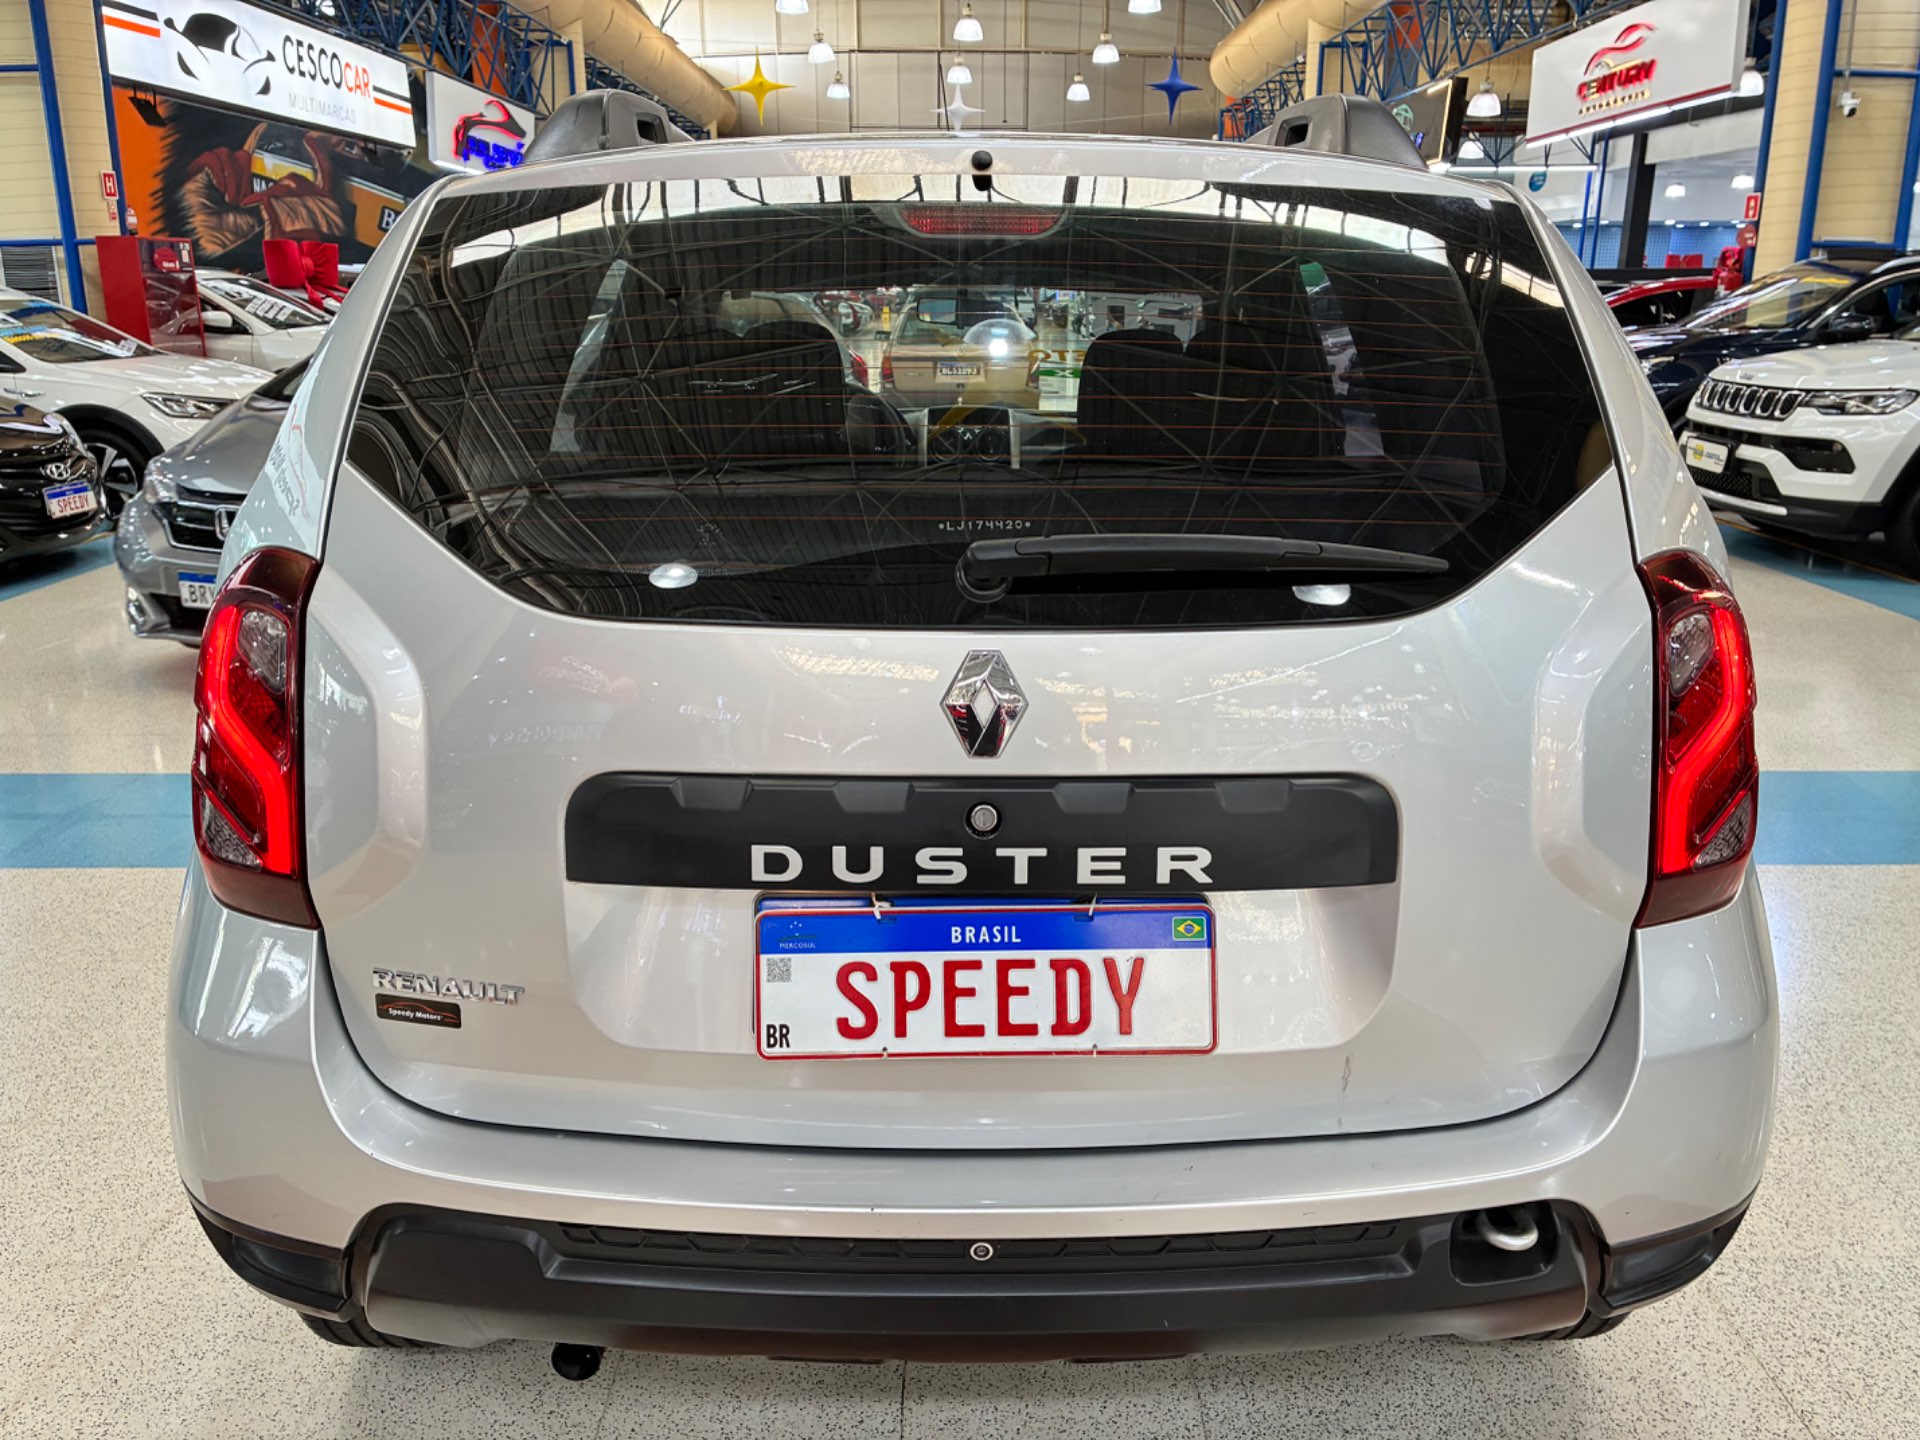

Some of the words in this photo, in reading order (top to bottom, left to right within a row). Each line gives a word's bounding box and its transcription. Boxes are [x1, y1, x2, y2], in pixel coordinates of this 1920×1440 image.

[282, 34, 371, 98] CESCOCAR
[1577, 58, 1657, 102] CENTURY
[288, 92, 357, 124] MULTIMARCAS
[105, 176, 115, 195] H
[57, 493, 90, 513] SPEEDY
[750, 844, 1214, 885] DUSTER
[779, 942, 816, 950] MERCOSUL
[950, 925, 1022, 944] BRASIL
[372, 967, 525, 1005] RENAULT
[836, 957, 1145, 1041] SPEEDY
[388, 1007, 415, 1020] Speedy
[415, 1011, 442, 1021] Motors
[766, 1023, 790, 1049] BR
